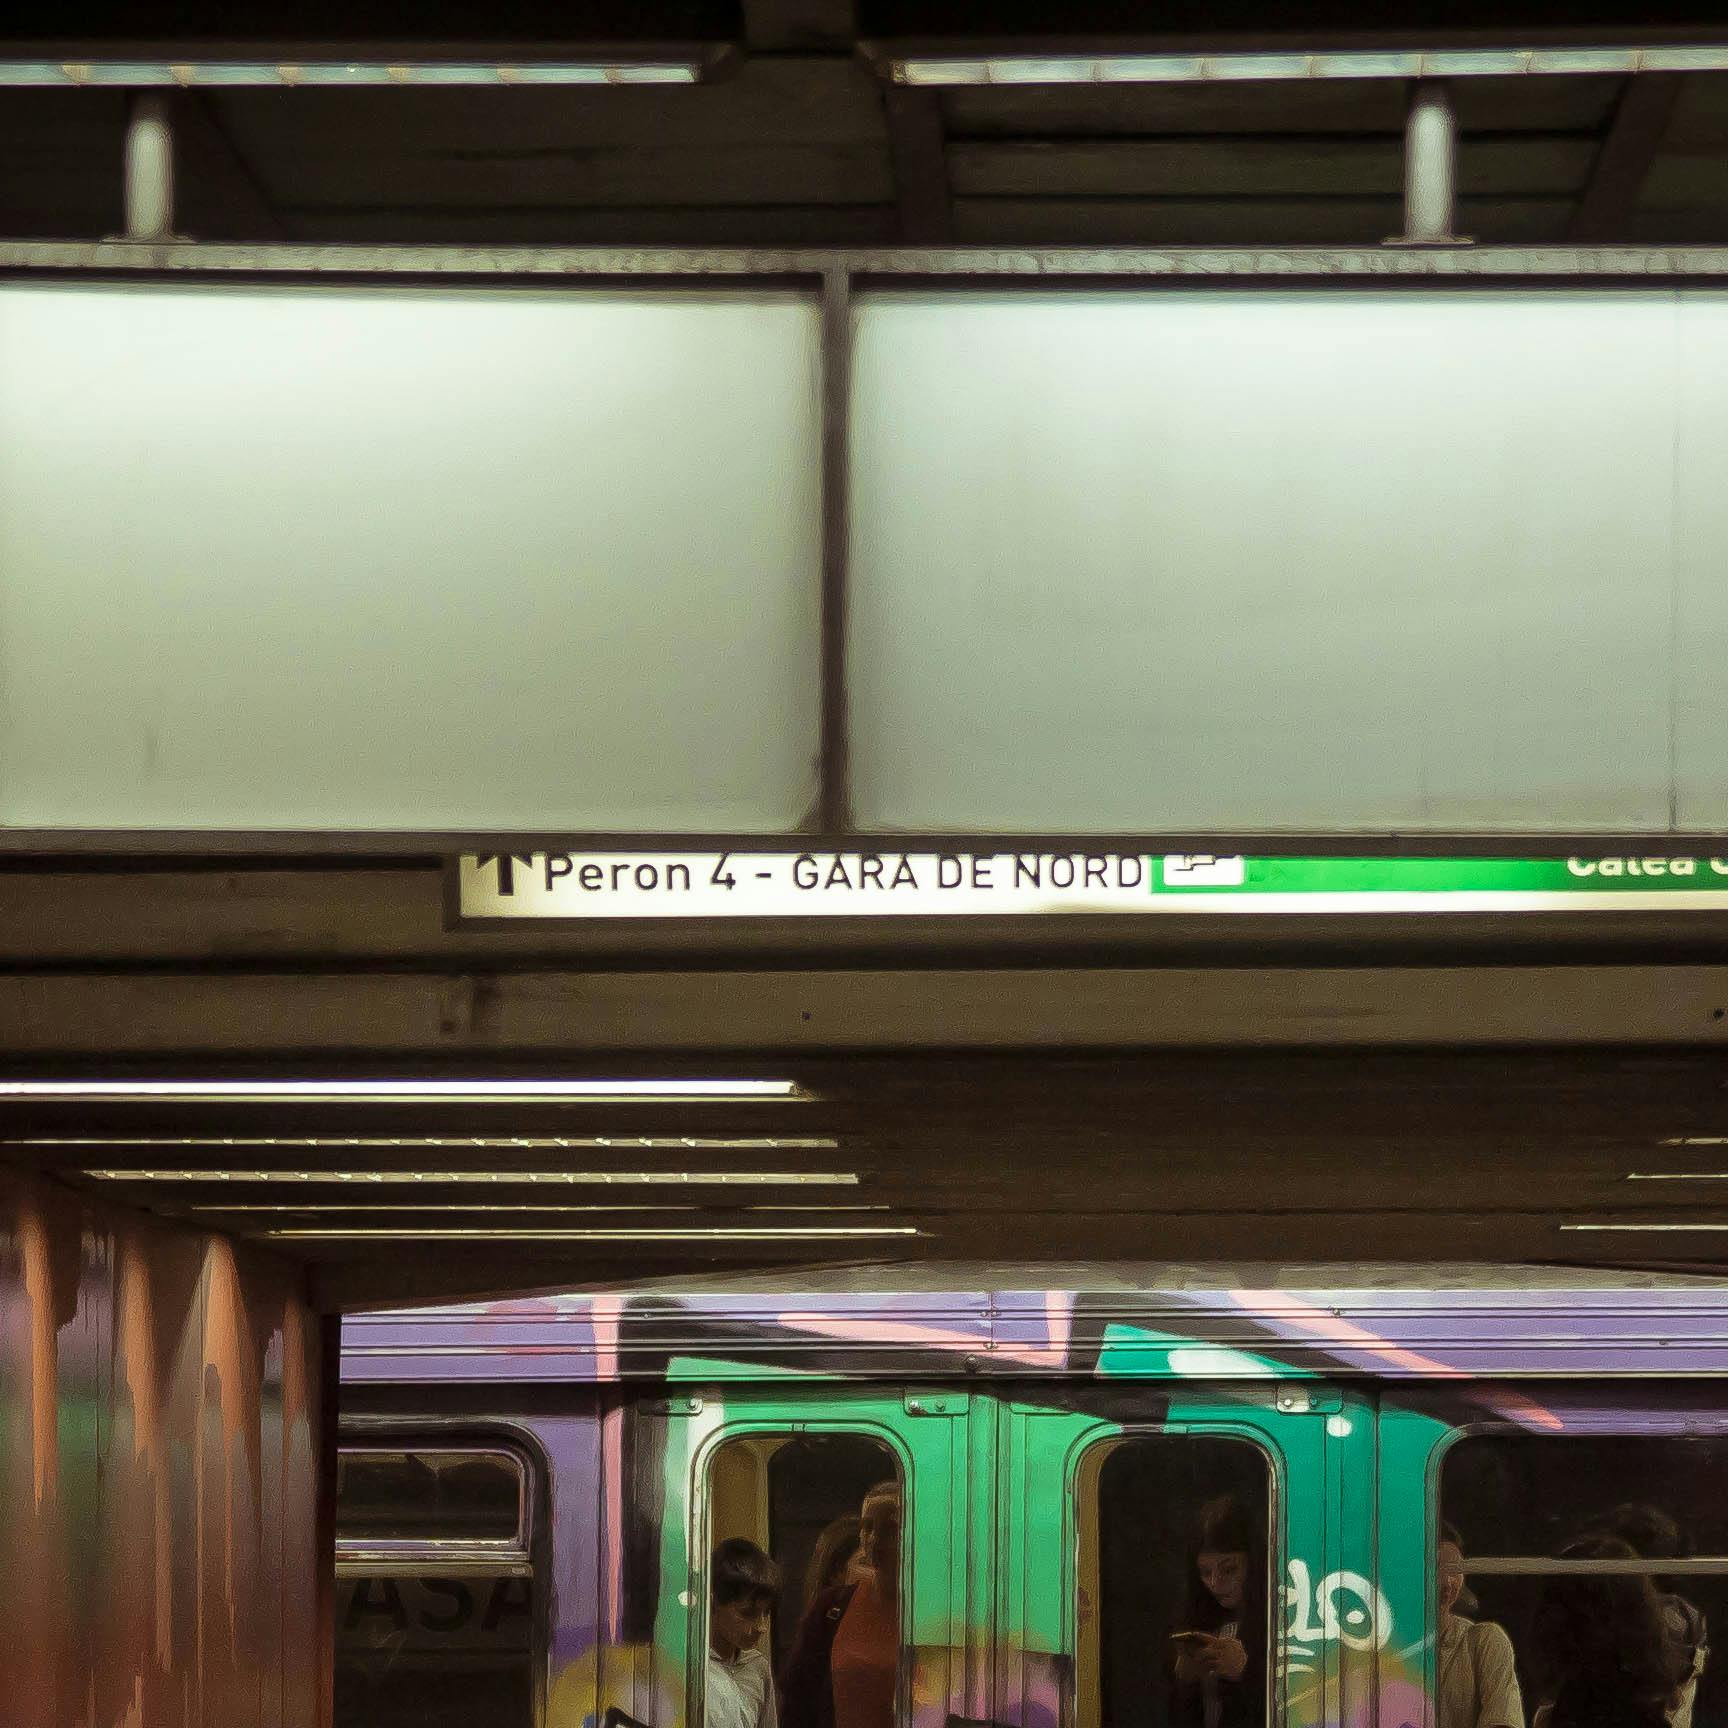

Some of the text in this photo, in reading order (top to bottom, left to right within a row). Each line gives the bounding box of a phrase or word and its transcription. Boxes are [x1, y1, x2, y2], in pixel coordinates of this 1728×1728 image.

[545, 851, 691, 891] Peron
[710, 851, 736, 890] 4
[793, 853, 920, 889] GARA
[938, 854, 994, 888] DE
[1014, 853, 1143, 888] NORD
